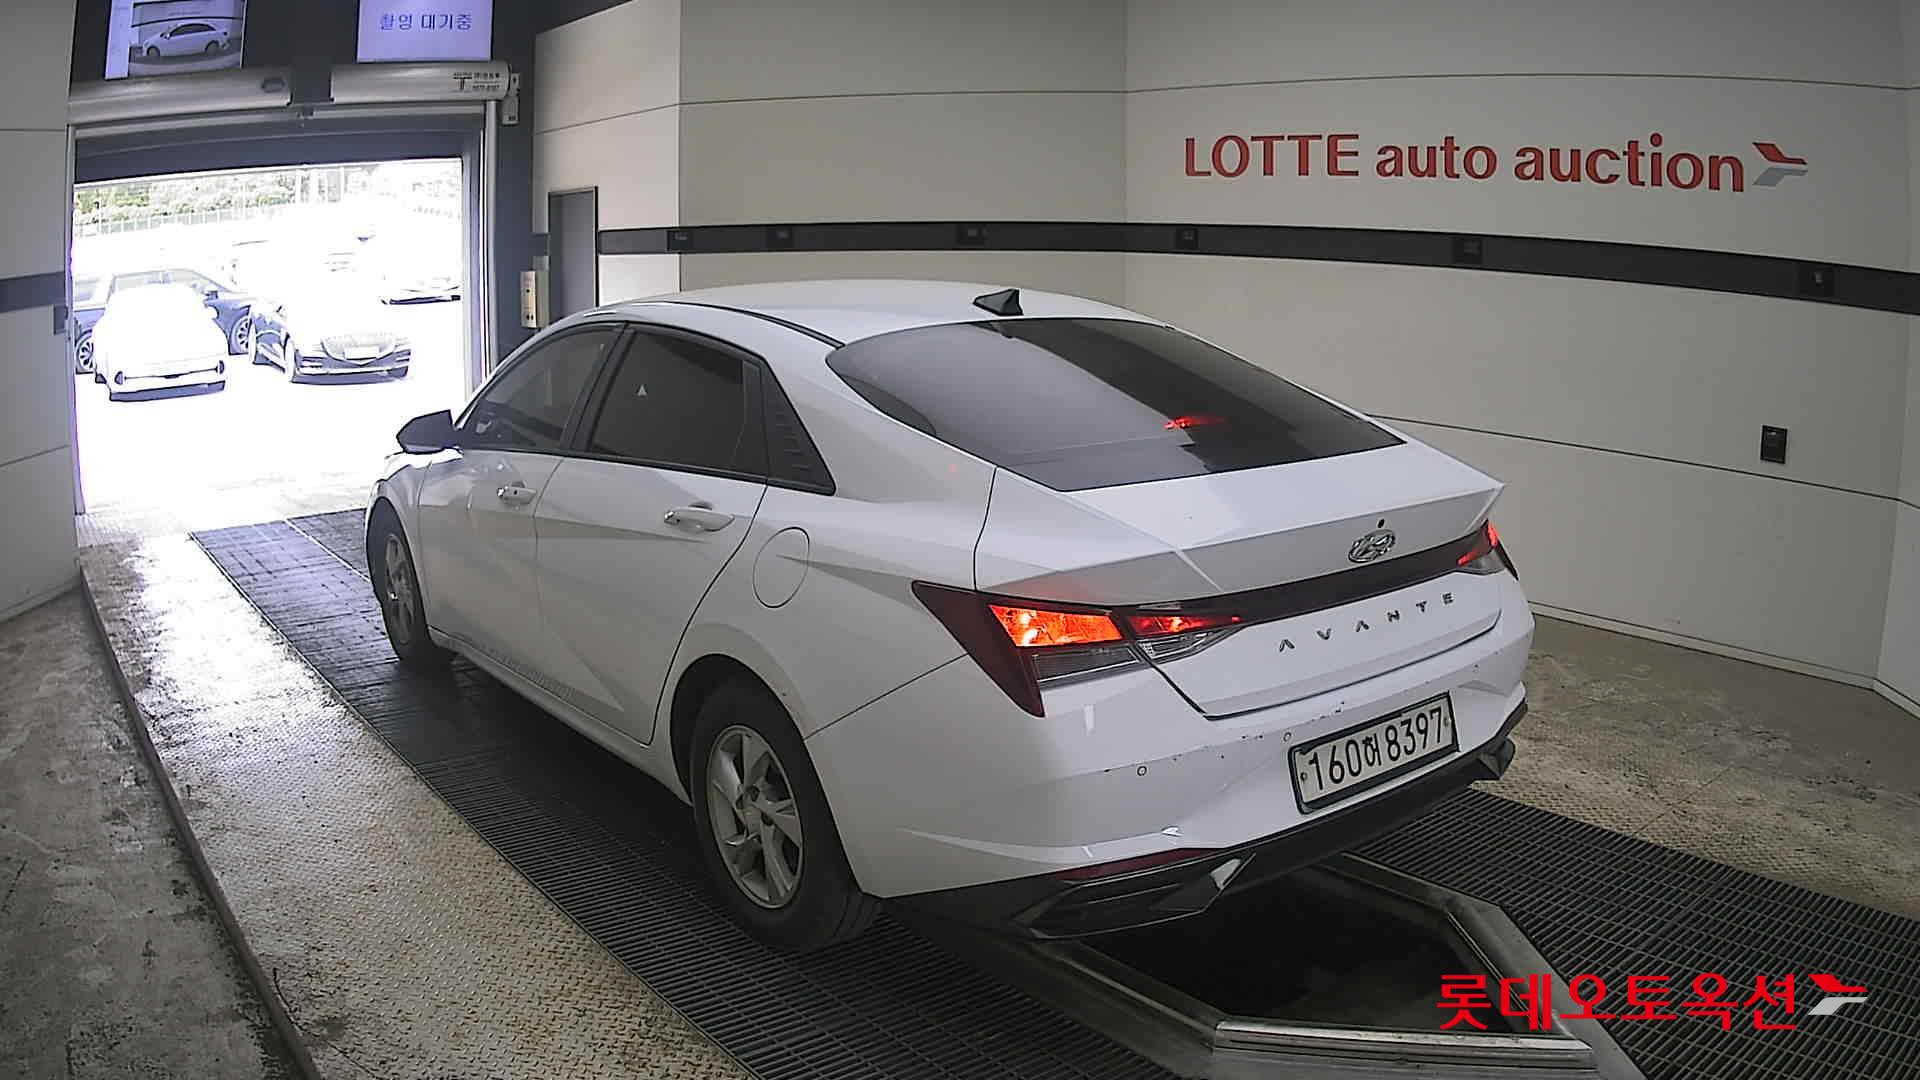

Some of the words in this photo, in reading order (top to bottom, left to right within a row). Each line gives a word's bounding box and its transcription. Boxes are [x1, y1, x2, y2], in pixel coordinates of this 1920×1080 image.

[420, 13, 473, 31] 대기중
[1184, 133, 1360, 177] LOTTE
[1376, 136, 1498, 179] auto
[1514, 133, 1744, 192] auction
[1278, 592, 1455, 652] AVANTE
